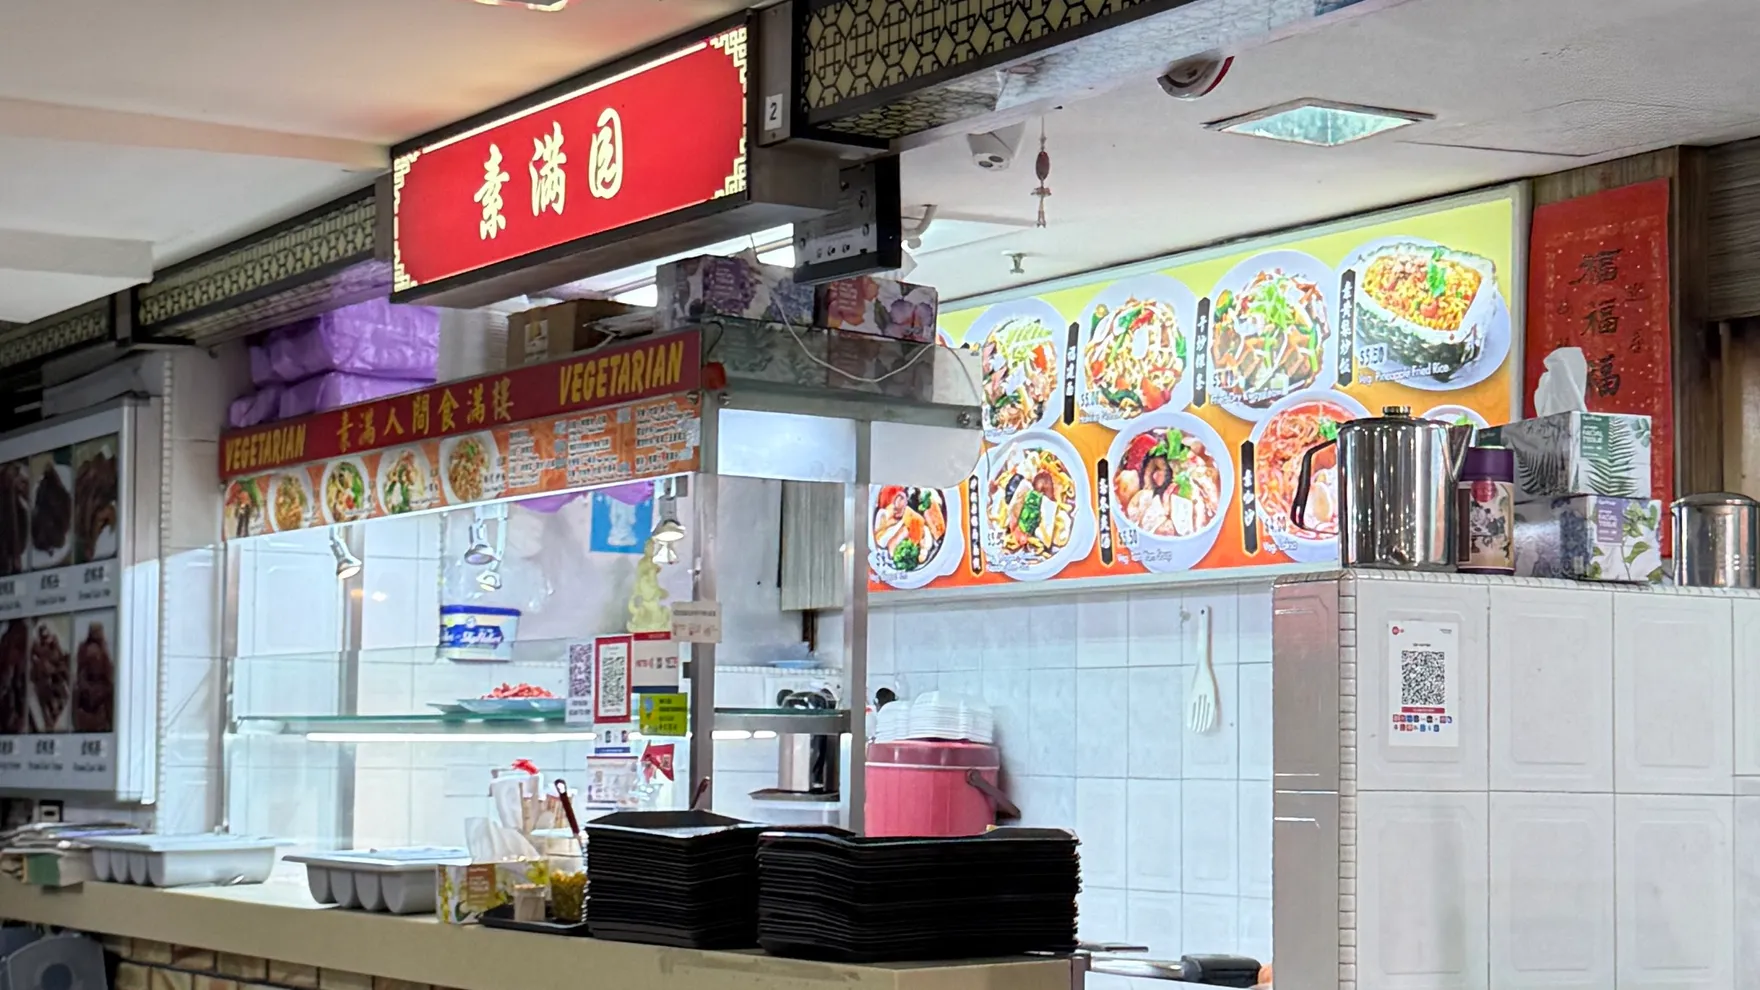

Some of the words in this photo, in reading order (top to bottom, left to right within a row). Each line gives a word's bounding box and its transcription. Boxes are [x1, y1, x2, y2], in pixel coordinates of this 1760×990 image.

[768, 101, 778, 121] 2
[559, 340, 684, 406] VEGETARIAN
[1411, 362, 1432, 377] Fried
[1432, 361, 1450, 375] Rice
[224, 423, 307, 473] VEGETARIAN
